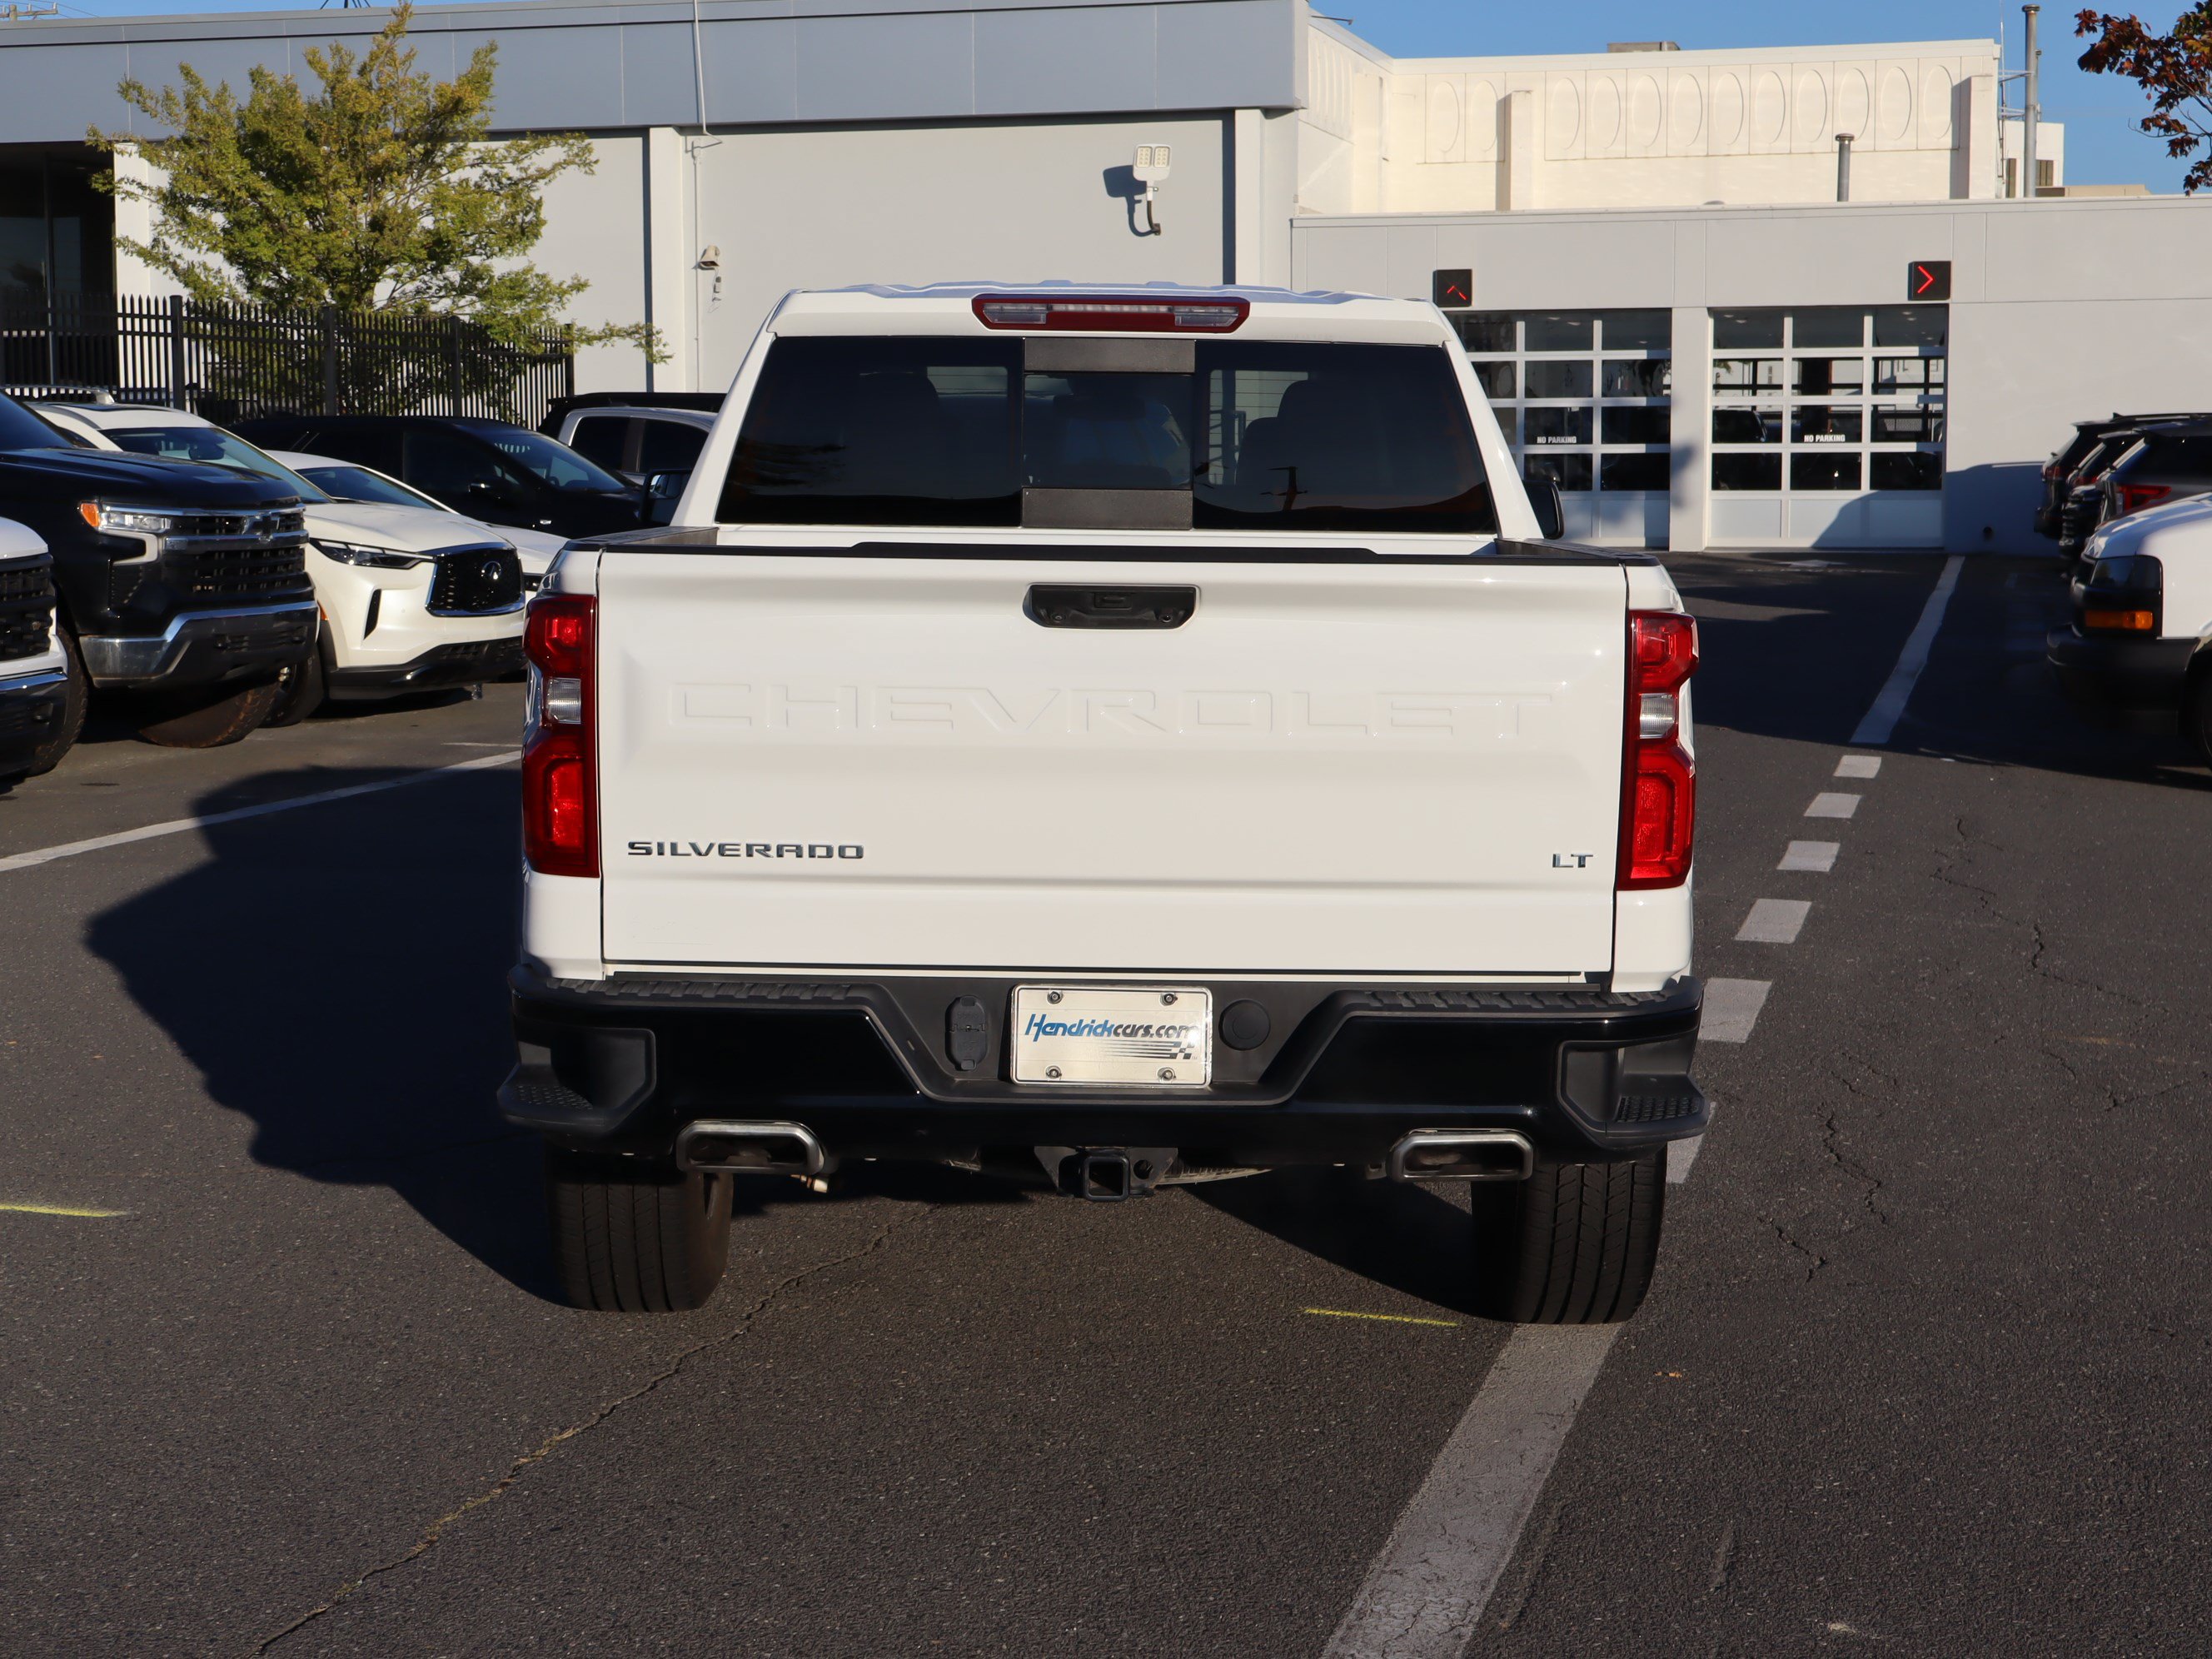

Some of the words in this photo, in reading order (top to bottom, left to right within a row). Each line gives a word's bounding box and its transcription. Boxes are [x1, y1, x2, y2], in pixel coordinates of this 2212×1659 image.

[1804, 434, 1814, 442] NO
[1816, 434, 1846, 442] PARKING
[668, 681, 1553, 739] CHEVROLET
[628, 841, 864, 859] SILVERADO
[1552, 854, 1593, 868] LT
